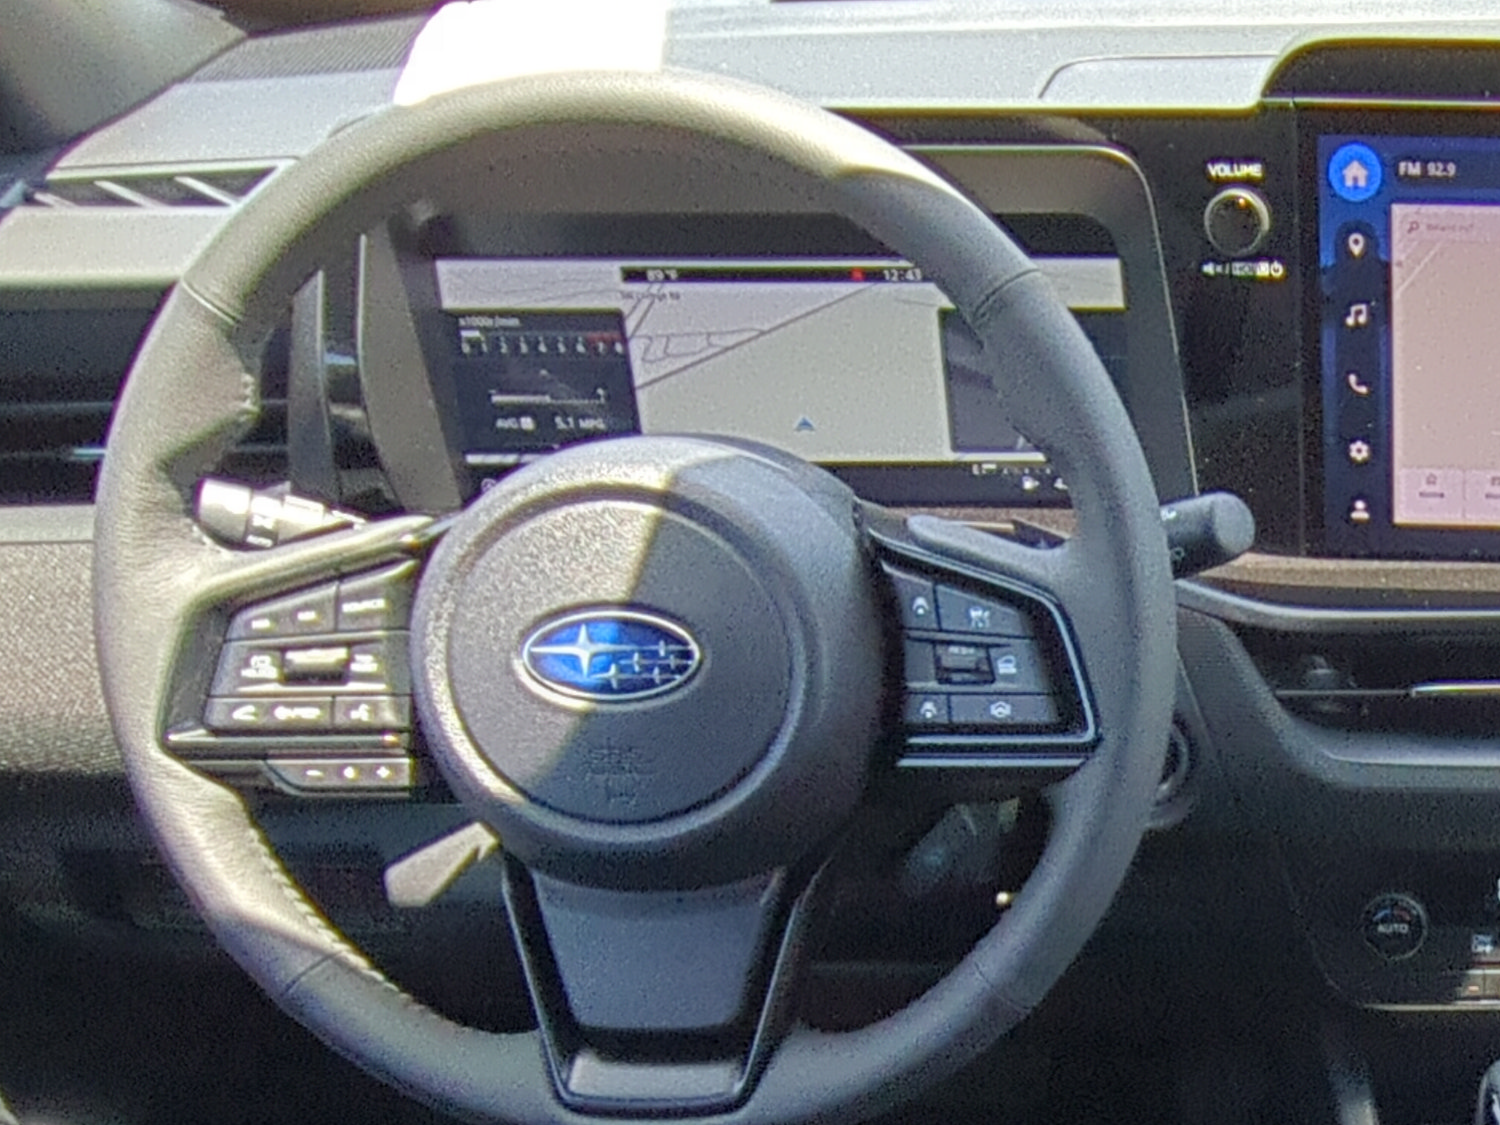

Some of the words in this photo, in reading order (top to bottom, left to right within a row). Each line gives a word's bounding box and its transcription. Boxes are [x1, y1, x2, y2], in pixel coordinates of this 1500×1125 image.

[1207, 162, 1263, 176] VOLUME
[1399, 162, 1422, 176] FM
[1427, 163, 1456, 177] 92.9
[1377, 922, 1409, 934] AUTO
